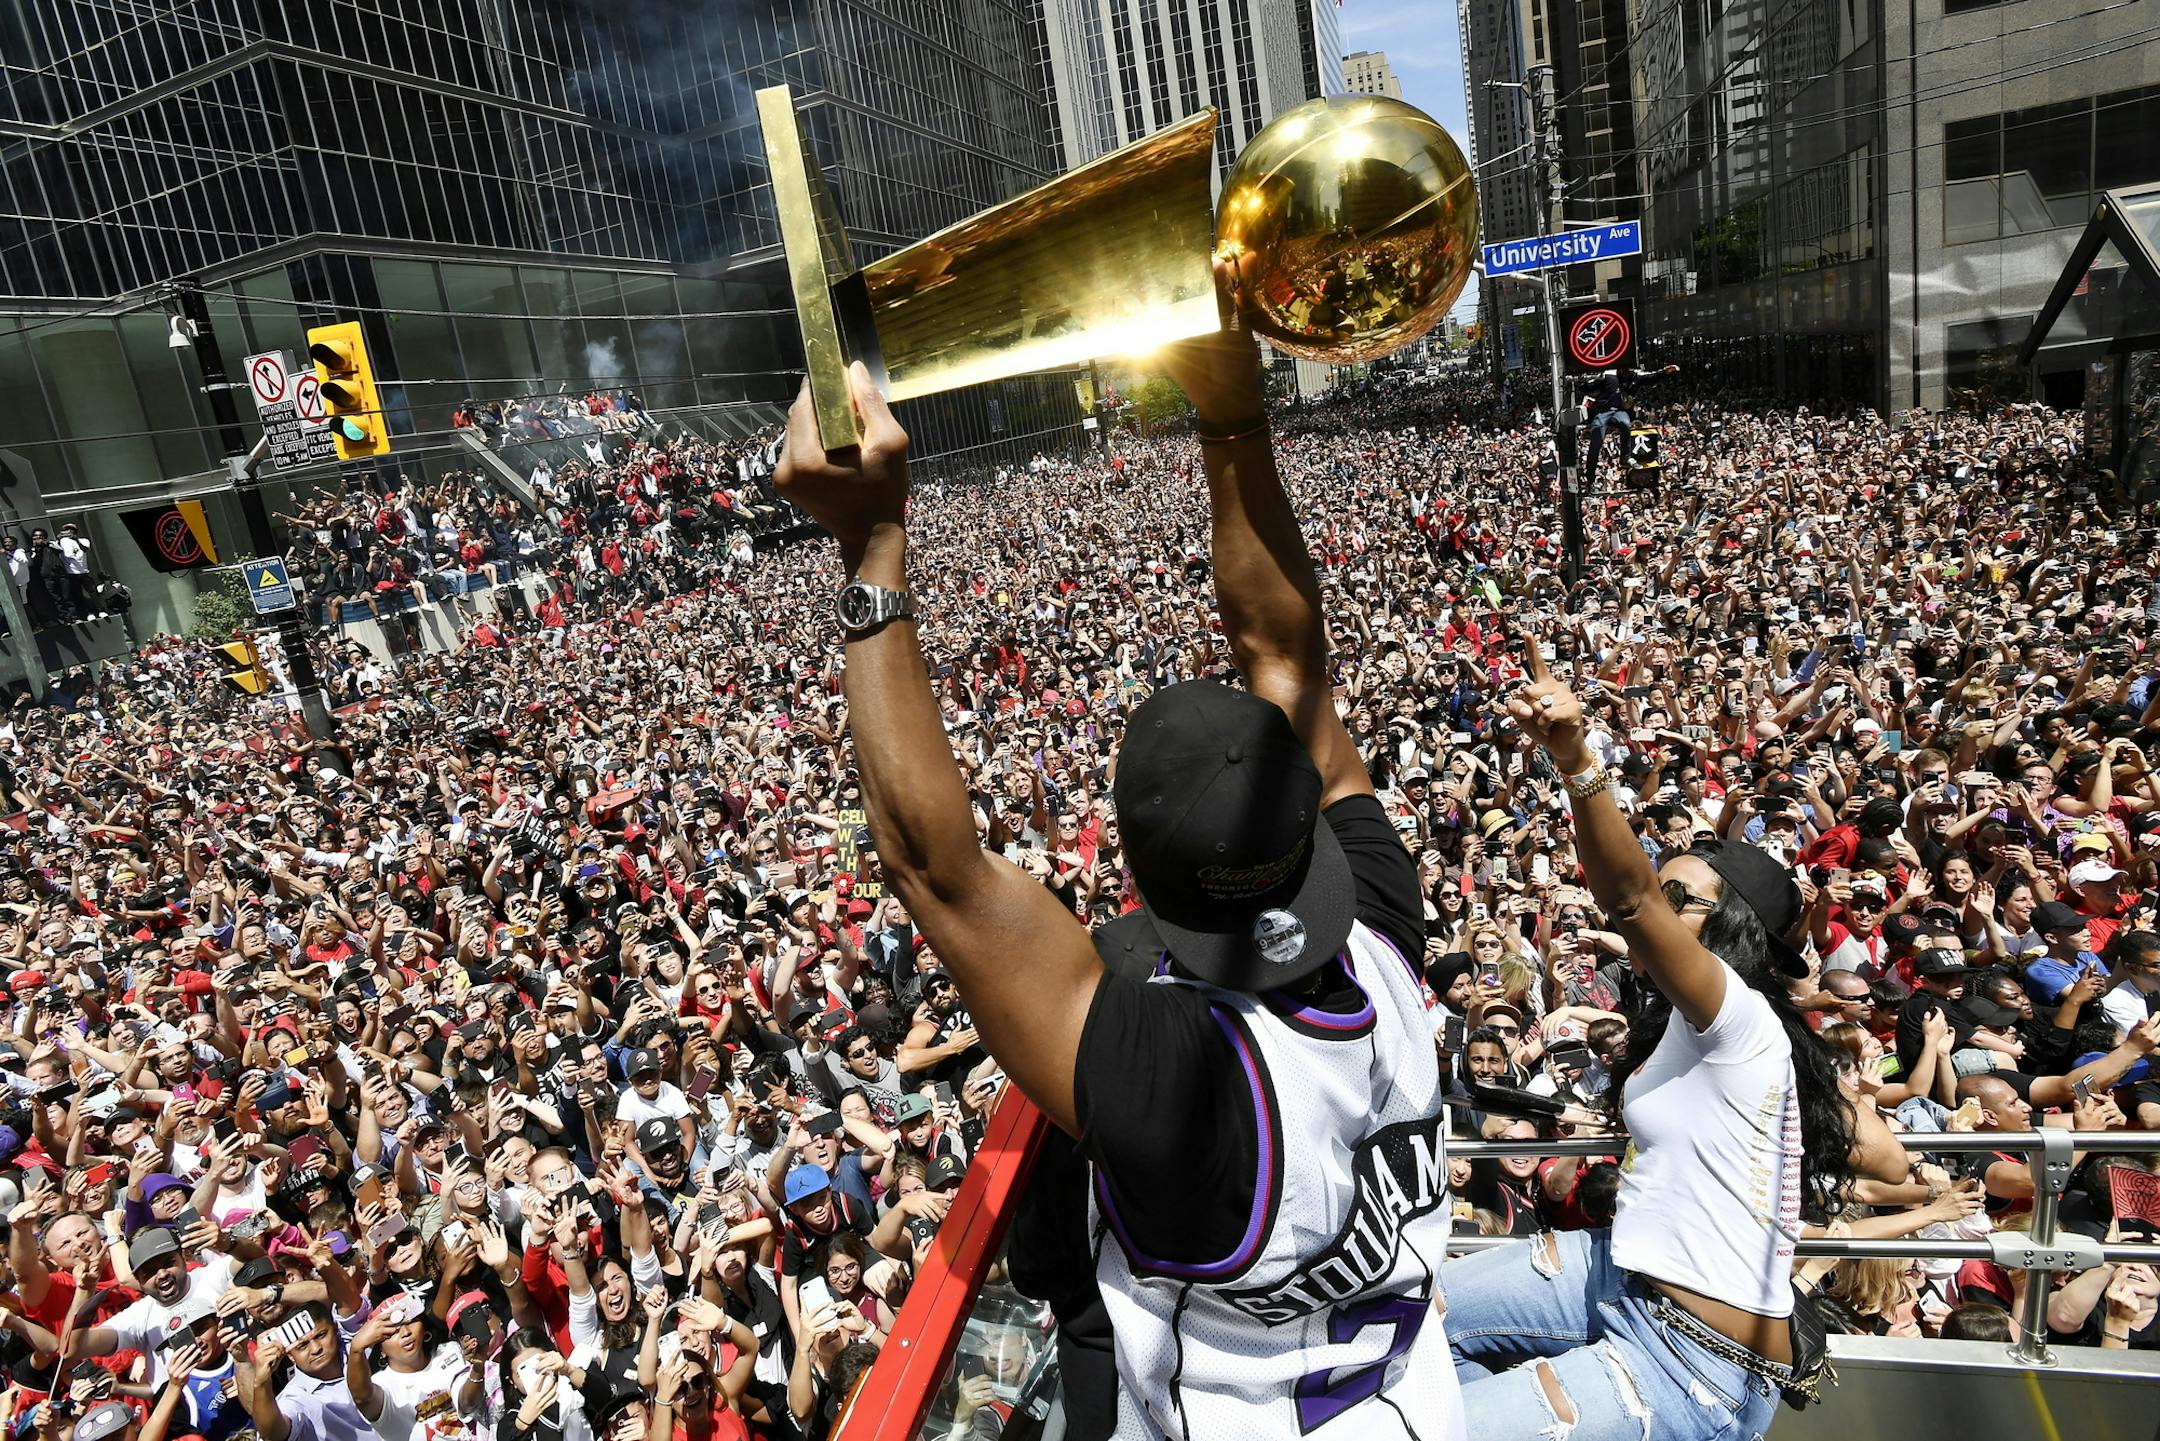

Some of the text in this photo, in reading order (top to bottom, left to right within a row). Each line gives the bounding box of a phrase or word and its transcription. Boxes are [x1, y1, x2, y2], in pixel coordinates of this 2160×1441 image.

[1491, 227, 1631, 268] University Ave
[260, 401, 294, 415] AUTHORIZED
[265, 420, 300, 435] AND BICYCLES
[271, 430, 299, 444] EXCEPTED
[246, 560, 280, 571] ATTENTION
[853, 882, 882, 898] OUR
[1294, 1293, 1432, 1437] 2
